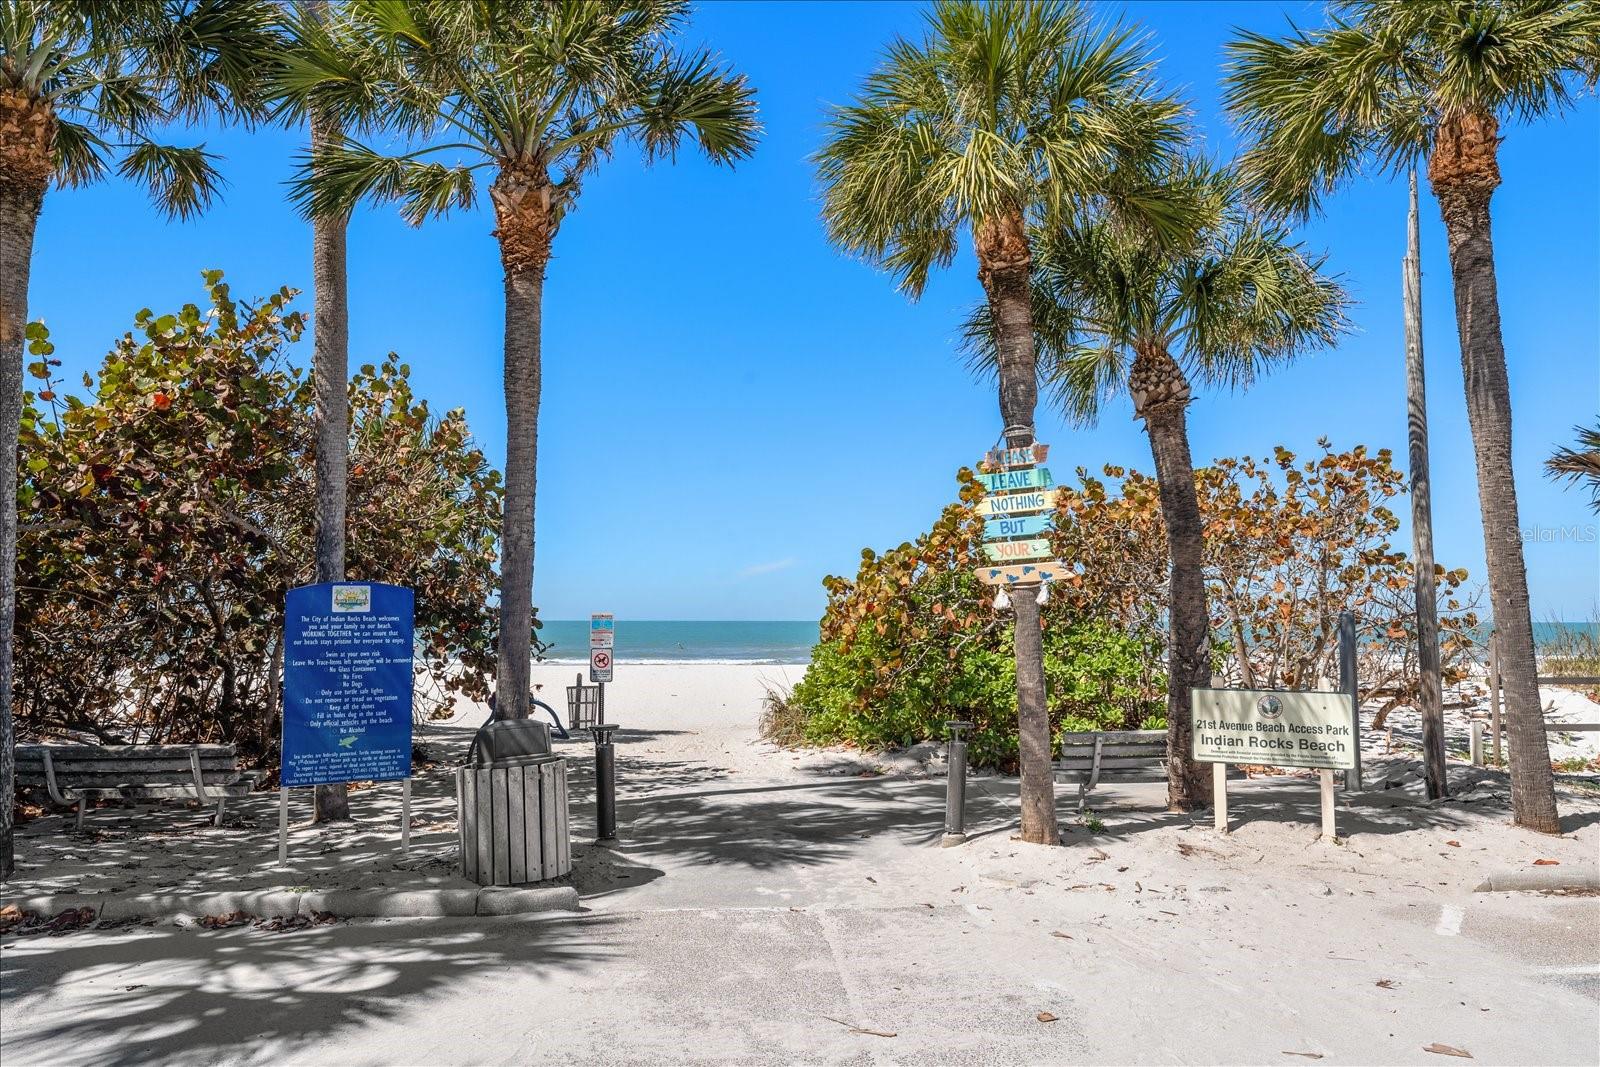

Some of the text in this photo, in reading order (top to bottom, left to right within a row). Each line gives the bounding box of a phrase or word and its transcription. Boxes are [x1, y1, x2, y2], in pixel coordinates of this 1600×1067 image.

[992, 472, 1032, 490] LEAVE
[990, 494, 1044, 512] NOTHING
[1000, 520, 1026, 534] BUT
[996, 543, 1030, 558] YOUR
[353, 658, 374, 666] overnight
[375, 695, 398, 703] vegetation
[310, 721, 321, 729] Only
[1196, 720, 1349, 736] 21st Avenue Beach Access Park
[1202, 734, 1345, 752] Indian Rocks Beach
